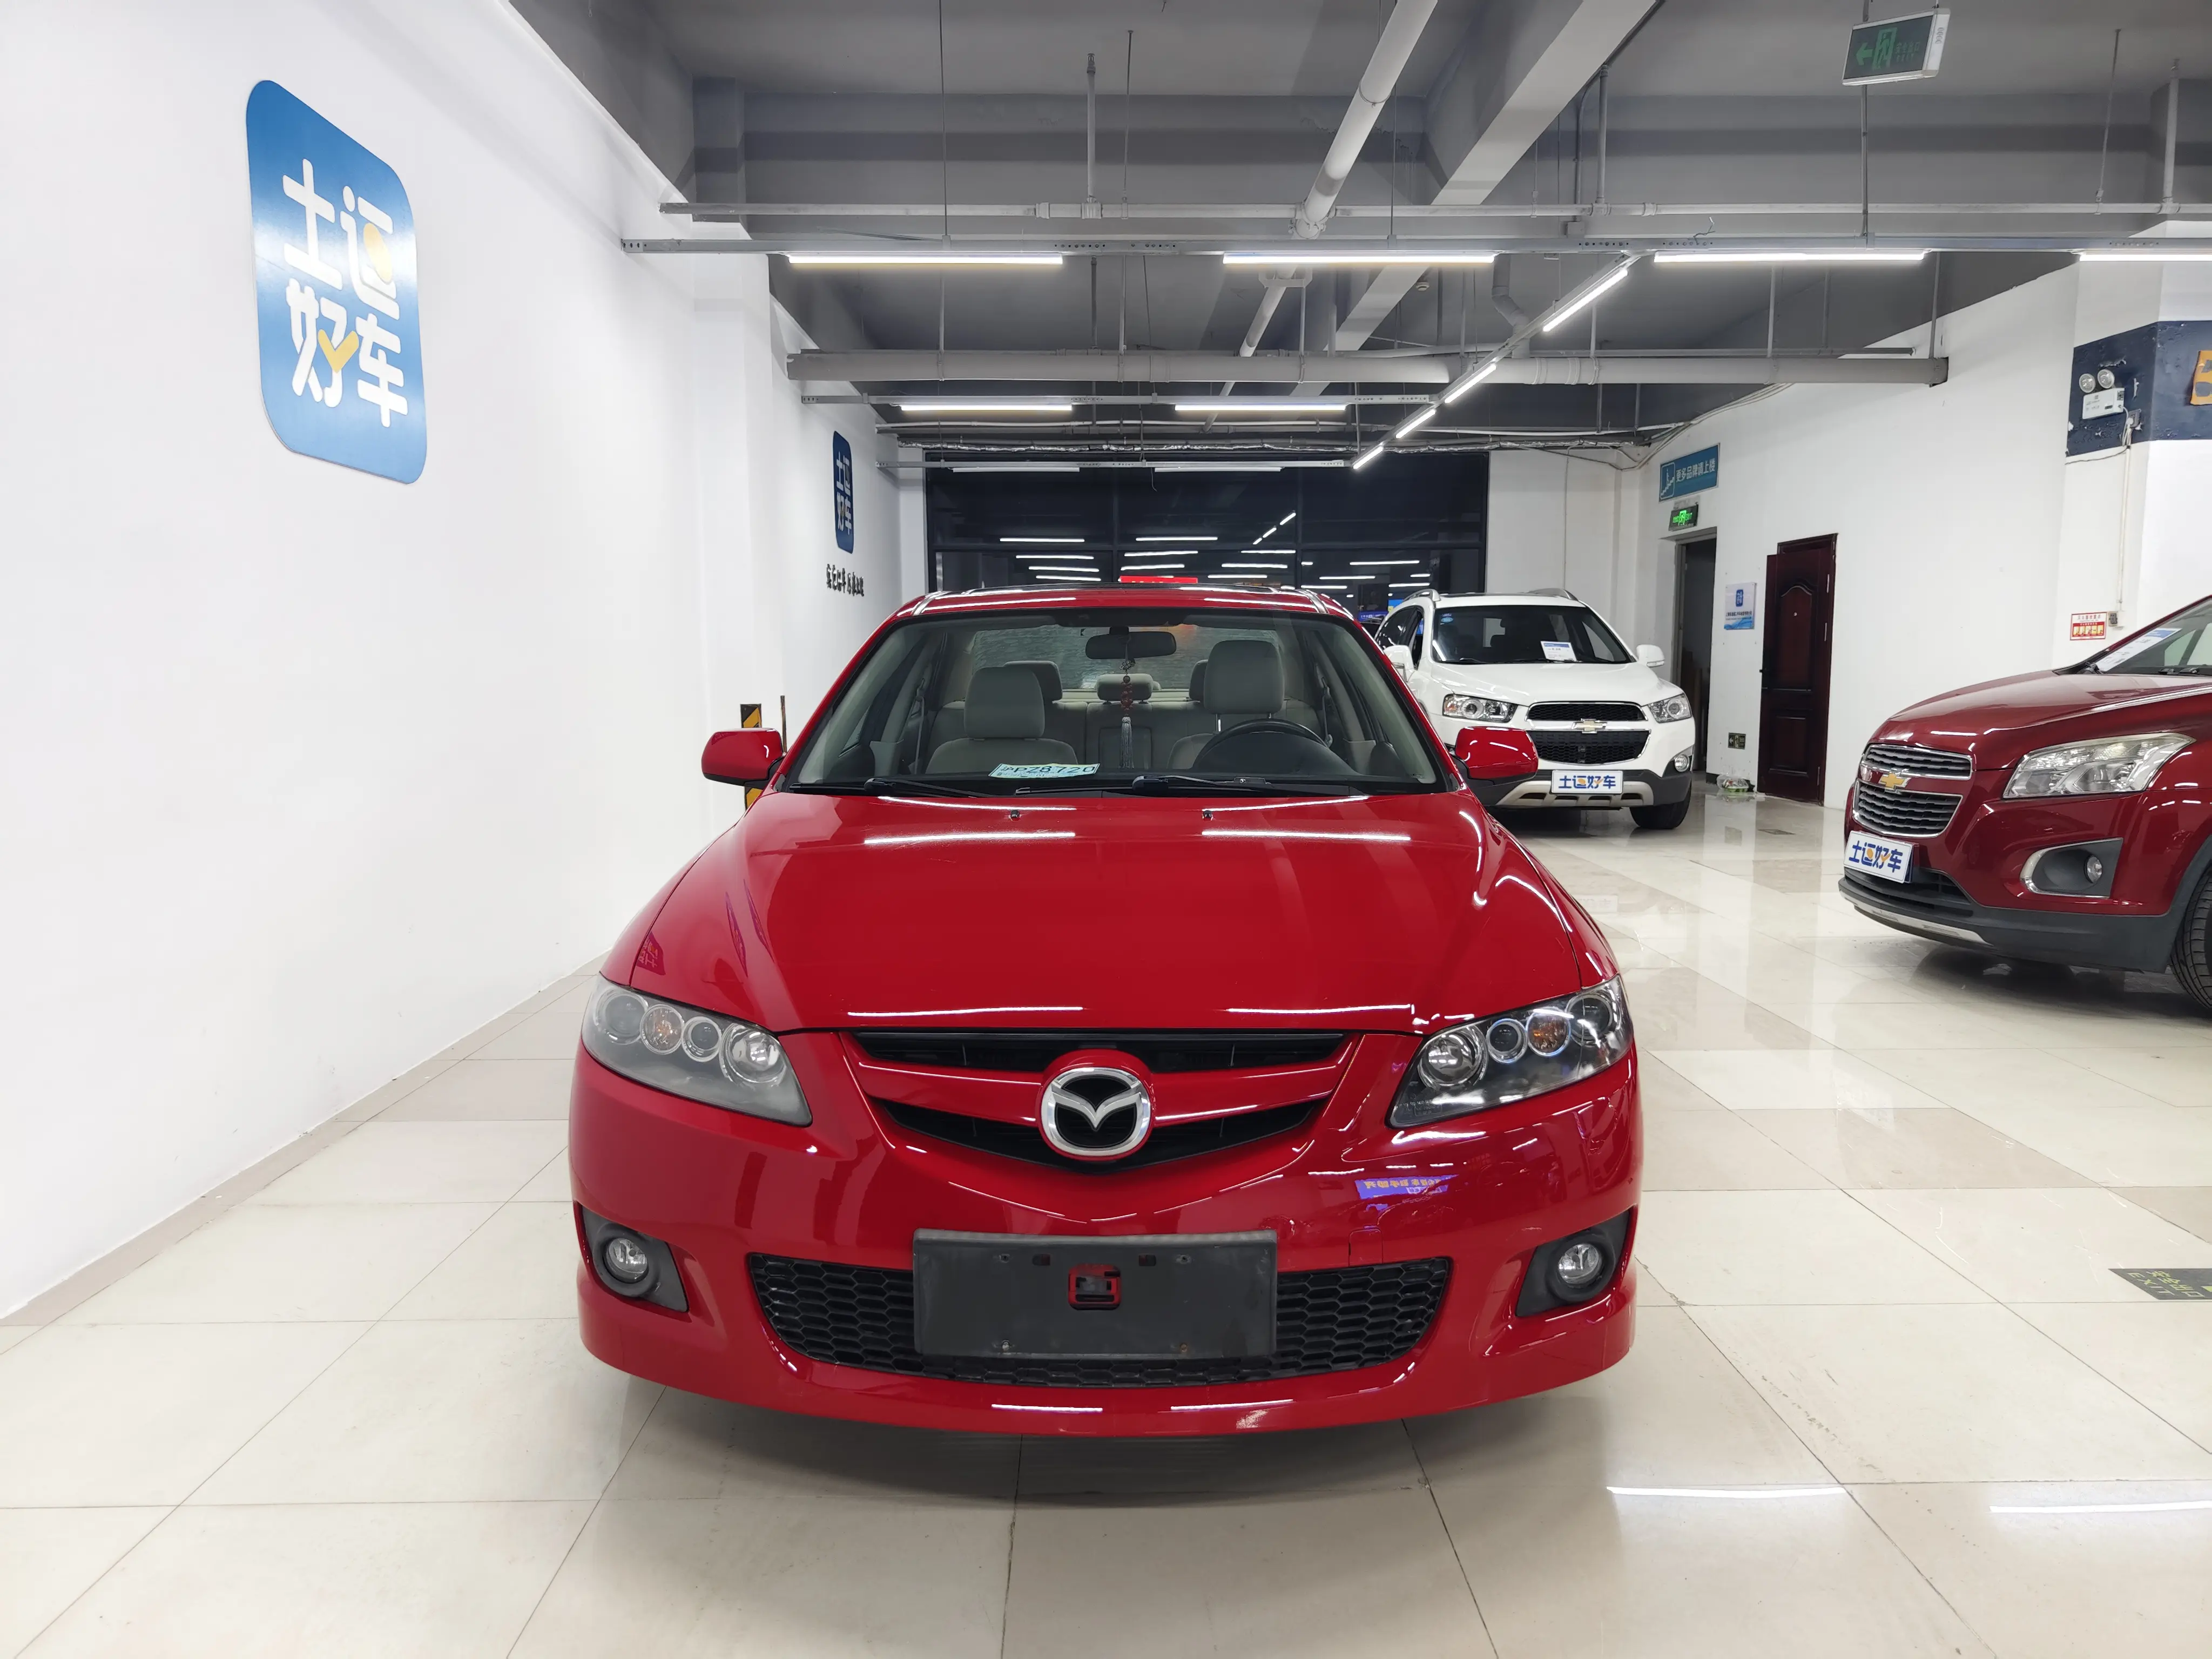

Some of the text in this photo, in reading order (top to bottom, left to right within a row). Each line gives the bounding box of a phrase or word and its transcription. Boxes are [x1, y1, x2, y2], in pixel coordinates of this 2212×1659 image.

[286, 278, 408, 428] 好车
[1676, 457, 1716, 482] 更多品牌请上楼
[2127, 1272, 2175, 1296] EXIT
[2146, 1271, 2206, 1297] 安全出口
